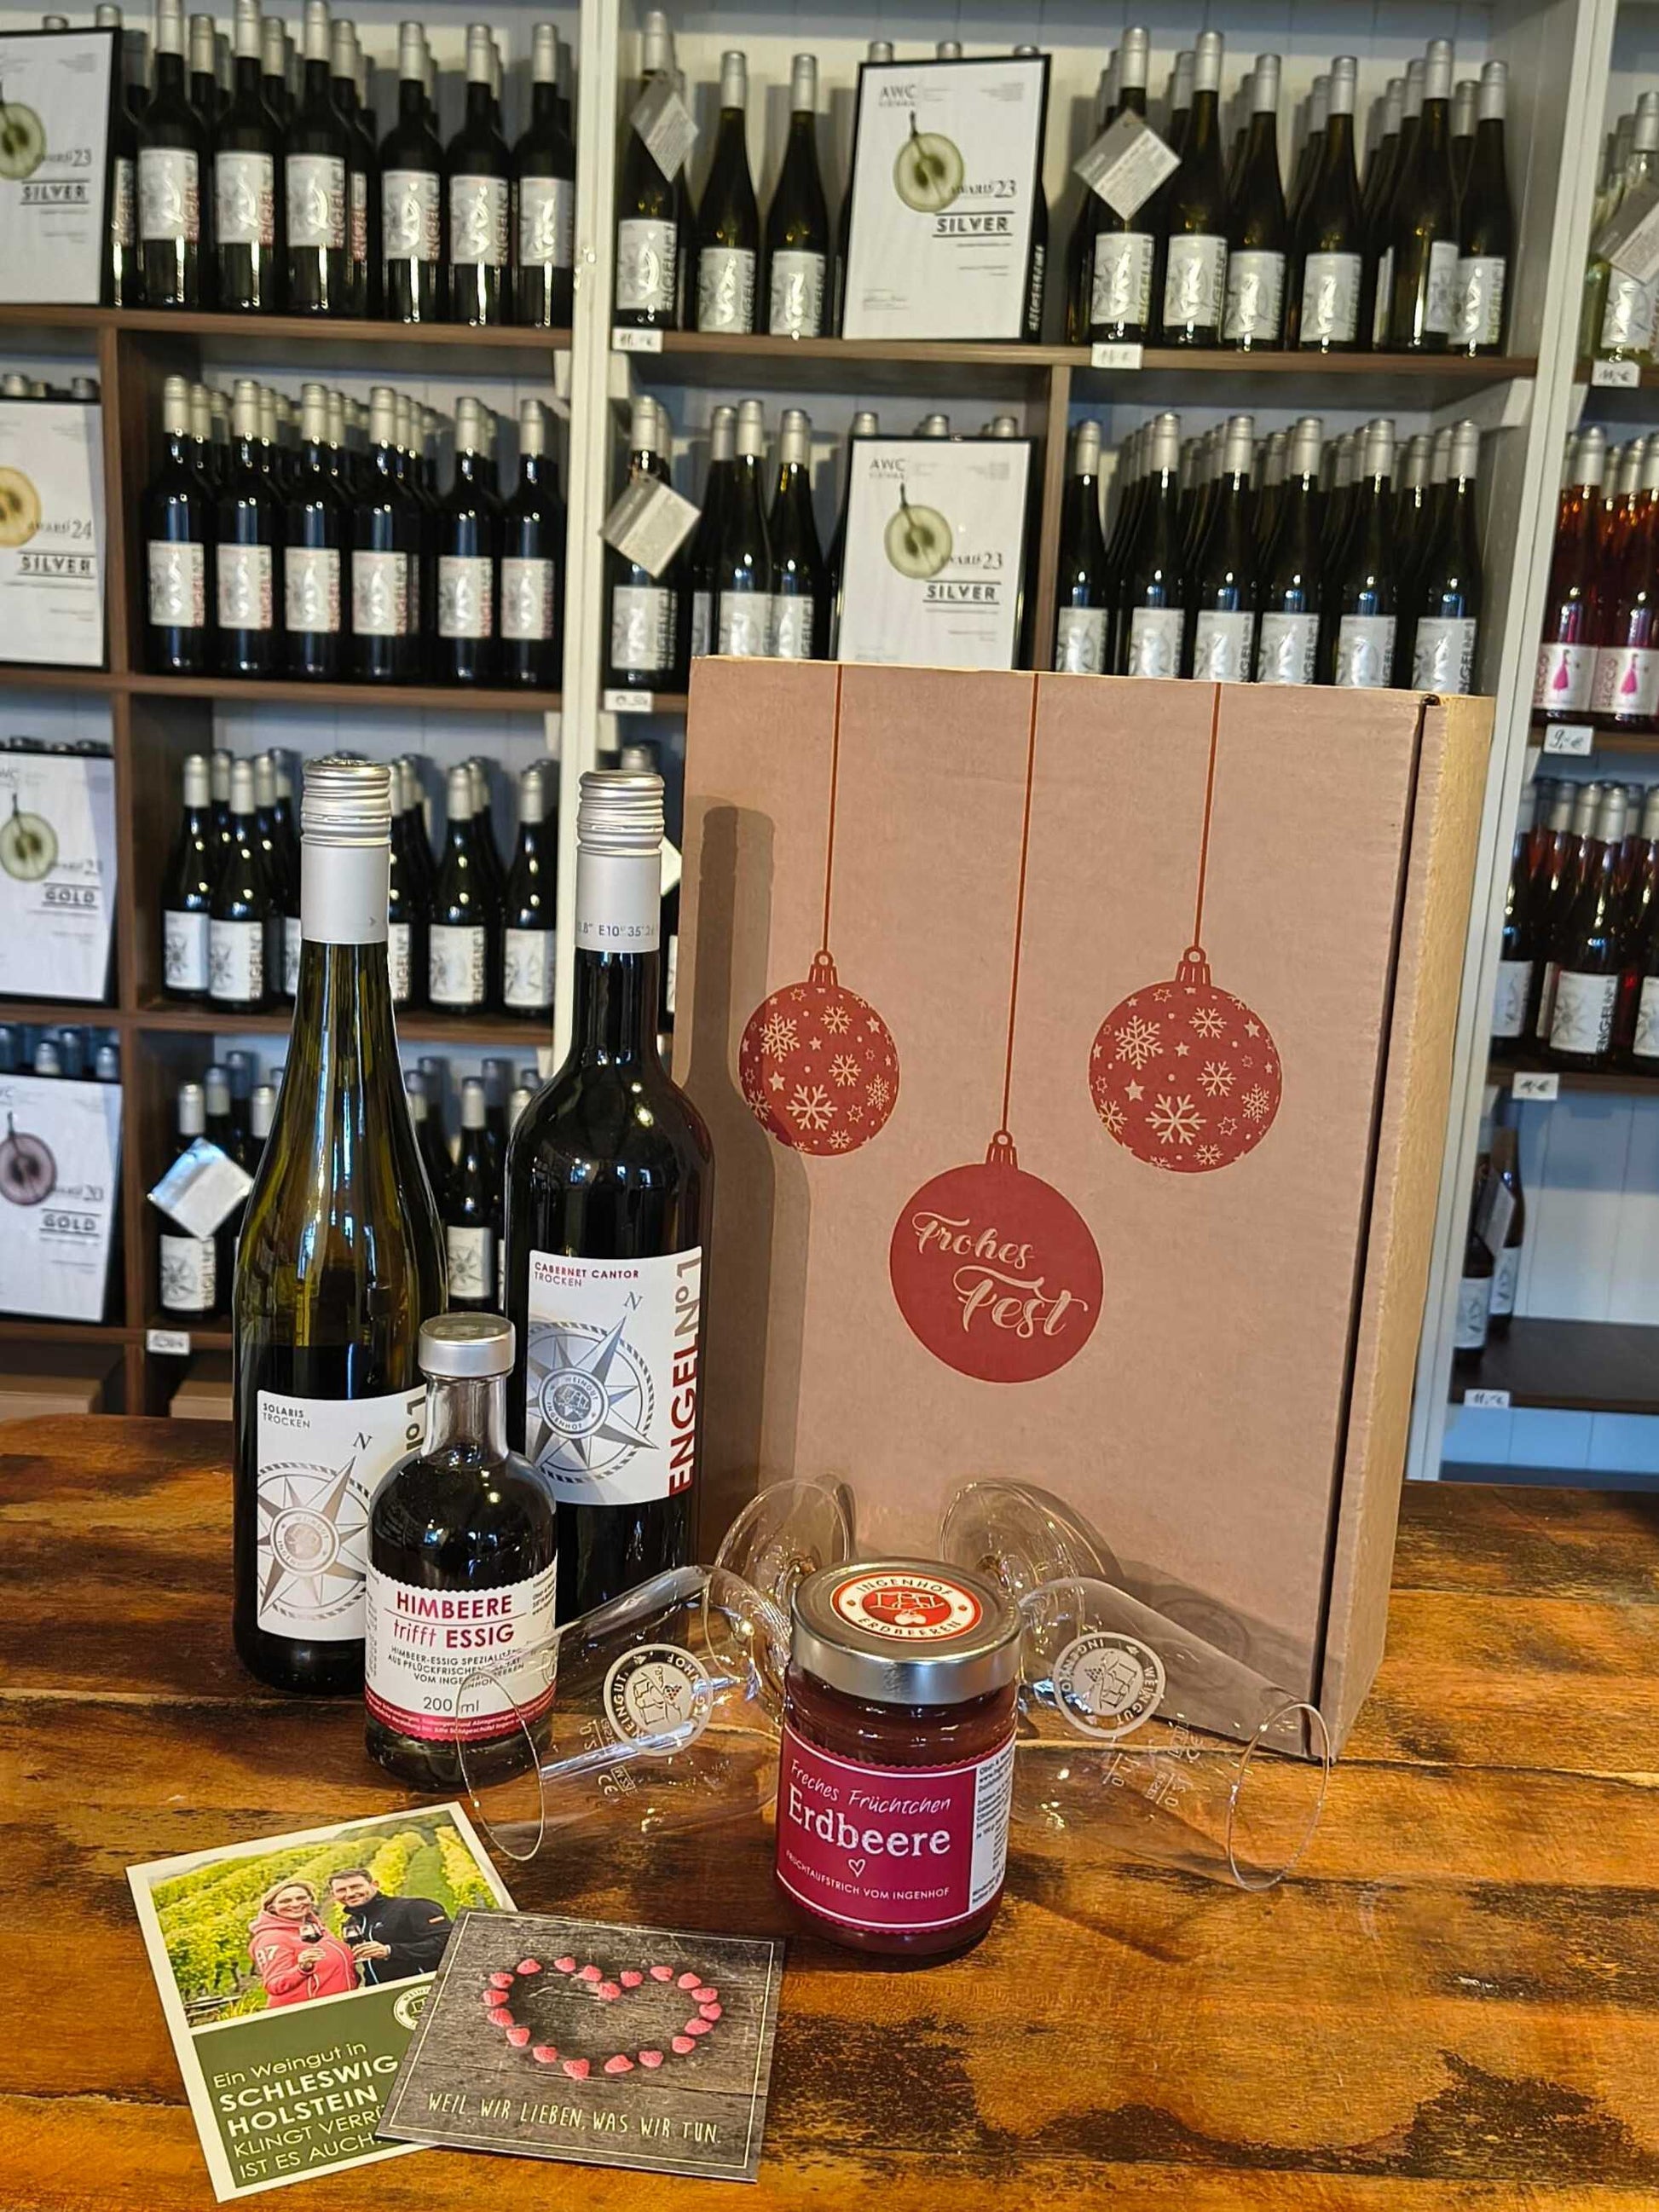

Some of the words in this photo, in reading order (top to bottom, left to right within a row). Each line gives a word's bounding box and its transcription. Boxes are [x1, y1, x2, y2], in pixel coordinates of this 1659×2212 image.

[936, 217, 1008, 233] SILVER
[21, 555, 91, 575] SILVER
[926, 585, 996, 600] SILVER
[43, 1214, 95, 1231] GOLD
[912, 1211, 1035, 1270] Frohes
[535, 1262, 587, 1279] CABERNET
[592, 1269, 639, 1279] CANTOR
[535, 1271, 582, 1288] TROCKEN
[622, 1291, 643, 1311] N
[953, 1265, 1089, 1338] Fest
[263, 1402, 304, 1418] SOLARIS
[262, 1412, 310, 1429] TROCKEN
[352, 1431, 373, 1451] N
[857, 1578, 953, 1596] INGENHOF
[397, 1591, 512, 1620] HIMBEERE
[394, 1620, 436, 1647] trifft
[446, 1624, 515, 1649] ESSIG
[858, 1617, 962, 1636] ERDBEEREN
[388, 1654, 402, 1666] AUS
[390, 1645, 459, 1666] HIMBEER-ESSIG
[413, 1672, 436, 1684] VOM
[423, 1696, 453, 1712] 200
[460, 1699, 479, 1714] ml
[791, 1759, 840, 1801] Freches
[848, 1789, 951, 1815] Früchtchen
[789, 1782, 951, 1857] Erdbeere
[864, 1887, 889, 1900] VOM
[893, 1886, 951, 1900] INGENHOF
[213, 2071, 246, 2088] Ein
[251, 2046, 342, 2078] Weingut
[346, 2042, 367, 2058] in
[219, 2054, 399, 2112] SCHLESWIG
[228, 2084, 379, 2138] HOLSTEIN
[480, 2099, 512, 2120] WIR
[520, 2102, 586, 2130] LIEBEN,
[592, 2111, 629, 2134] WAS
[640, 2117, 671, 2138] WIR
[682, 2121, 721, 2144] TUN.
[234, 2126, 313, 2158] KLINGT
[240, 2158, 268, 2179] IST
[276, 2151, 301, 2170] ES
[309, 2131, 383, 2163] AUCH.
